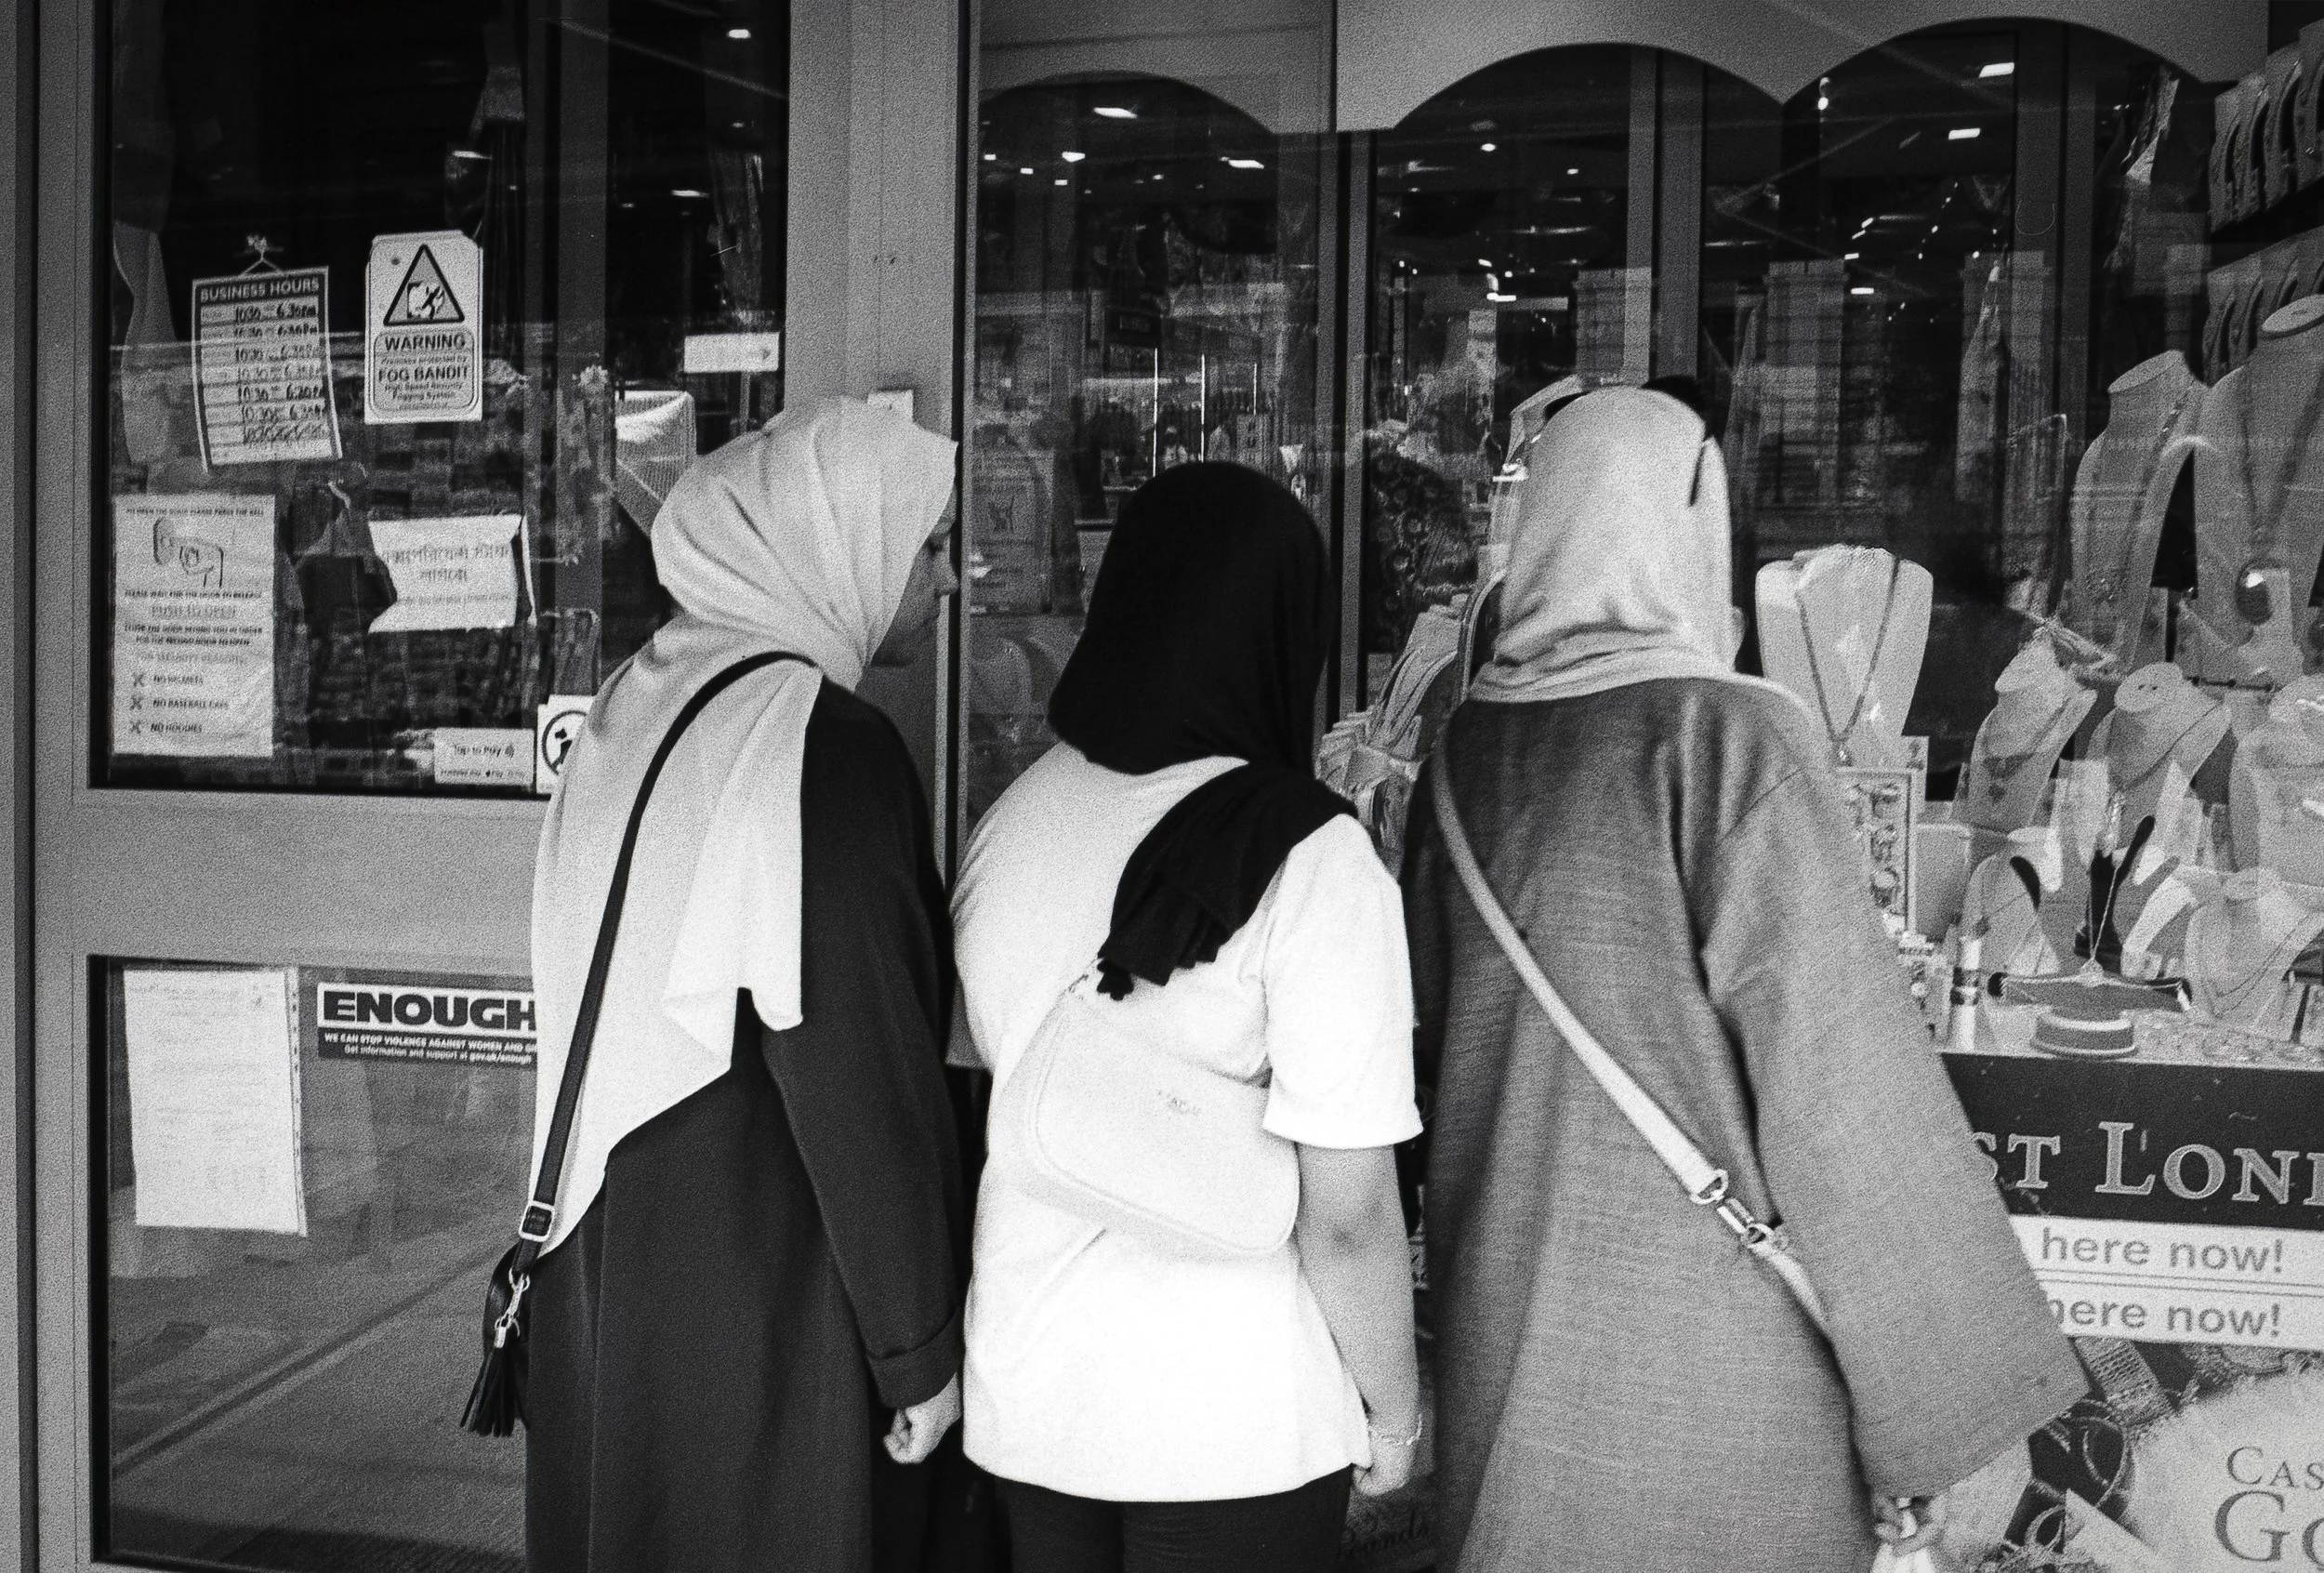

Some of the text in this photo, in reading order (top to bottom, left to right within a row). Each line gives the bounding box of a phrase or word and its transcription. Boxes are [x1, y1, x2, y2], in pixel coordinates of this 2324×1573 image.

[200, 276, 320, 303] BUSINESS HOURS
[384, 333, 466, 351] WARNING
[377, 364, 469, 383] FOG BANDIT
[152, 699, 166, 709] NO
[324, 990, 537, 1032] ENOUGH
[324, 1032, 339, 1043] WE
[340, 1033, 359, 1044] CAN
[360, 1034, 383, 1045] STOP
[383, 1035, 428, 1048] VIOLENCE
[428, 1038, 467, 1050] AGAINST
[467, 1039, 503, 1051] WOMEN
[503, 1041, 524, 1052] AND
[344, 1043, 359, 1055] Get
[360, 1045, 407, 1057] information
[408, 1049, 425, 1058] and
[425, 1050, 458, 1061] support
[2041, 1226, 2284, 1274] here now!
[2166, 1302, 2280, 1338] now!
